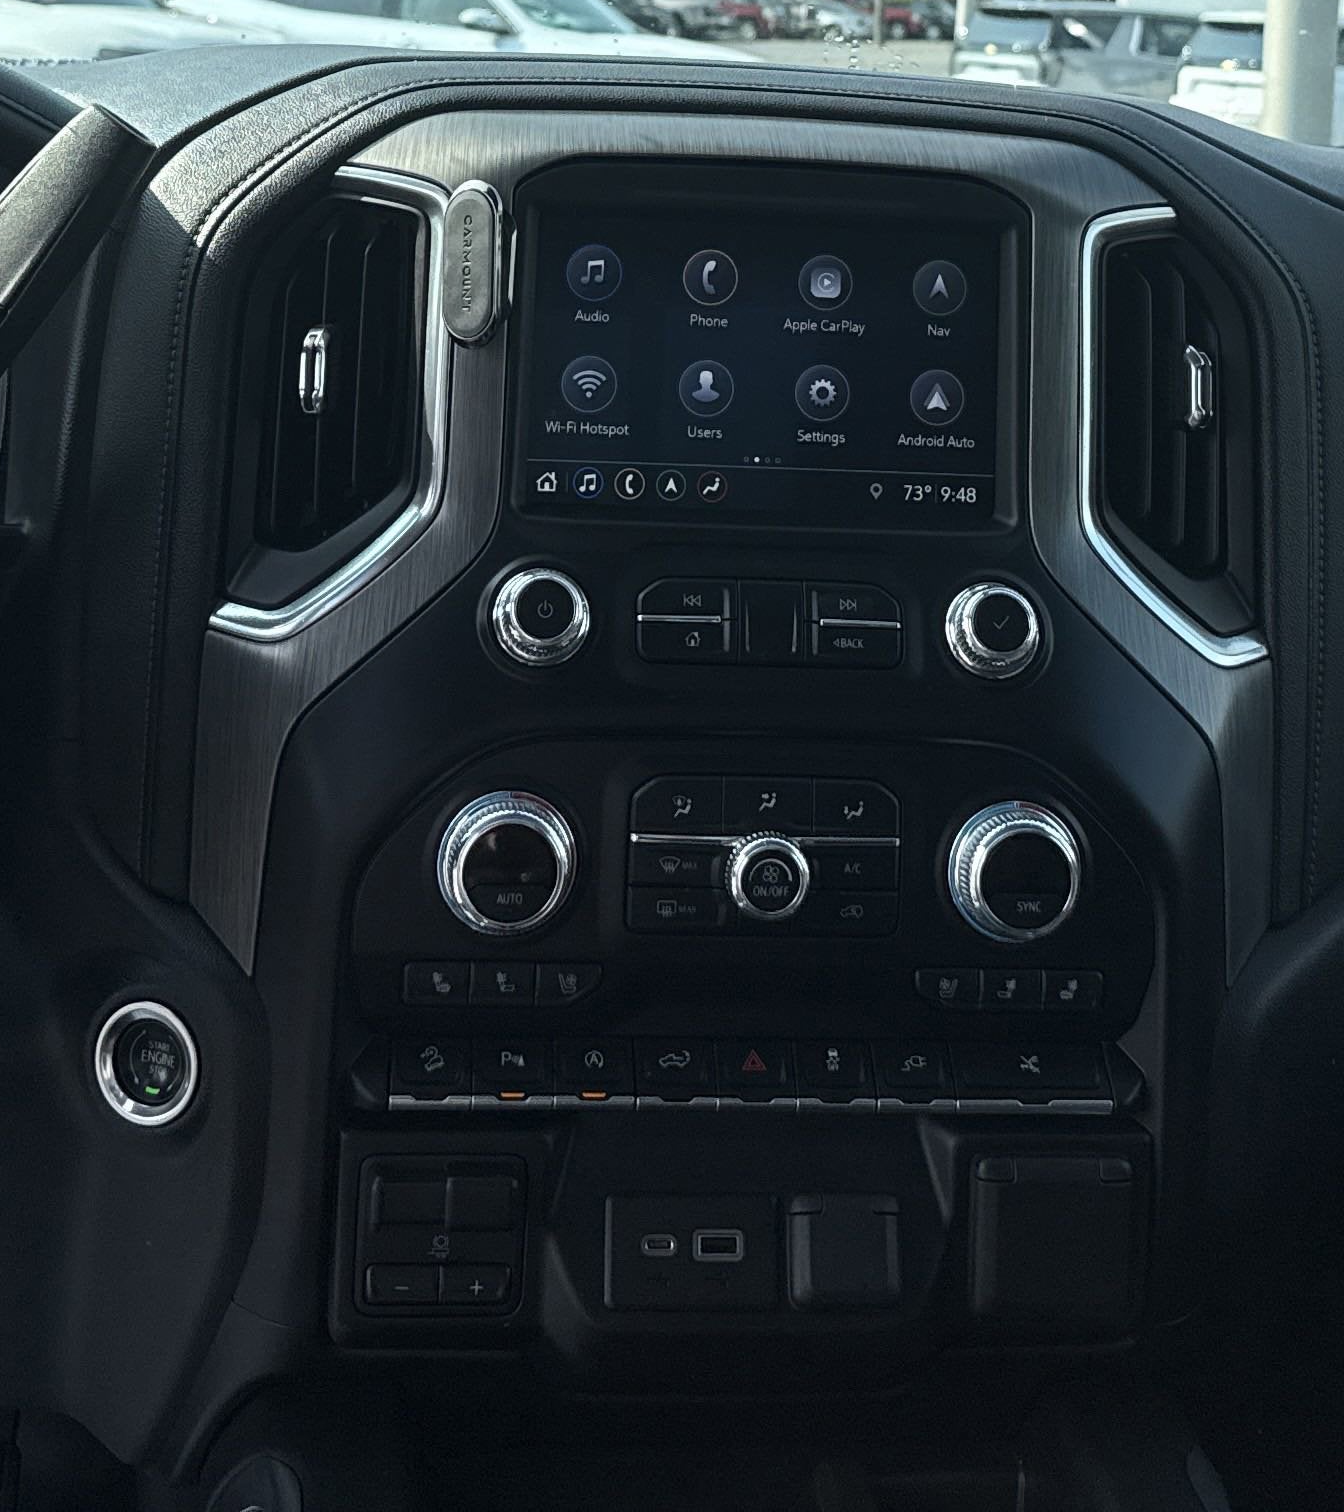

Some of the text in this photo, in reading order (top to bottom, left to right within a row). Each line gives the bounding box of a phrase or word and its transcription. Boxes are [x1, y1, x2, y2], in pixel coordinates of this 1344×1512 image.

[462, 214, 473, 313] CARMOUNT
[574, 309, 610, 323] Audio
[689, 313, 729, 327] Phone
[783, 318, 866, 336] Apple CarPlay
[927, 324, 951, 337] Nav
[544, 420, 630, 438] Wi-Fi Hotspot
[687, 425, 723, 439] Users
[797, 429, 846, 446] Settings
[897, 433, 975, 448] Android Auto
[903, 484, 977, 503] 73° 9:48
[840, 638, 864, 649] BACK
[844, 862, 862, 875] A/C
[496, 892, 523, 904] AUTO
[753, 885, 790, 898] ON/OFF
[1016, 901, 1042, 914] SYNC
[141, 1048, 176, 1069] ENGINE
